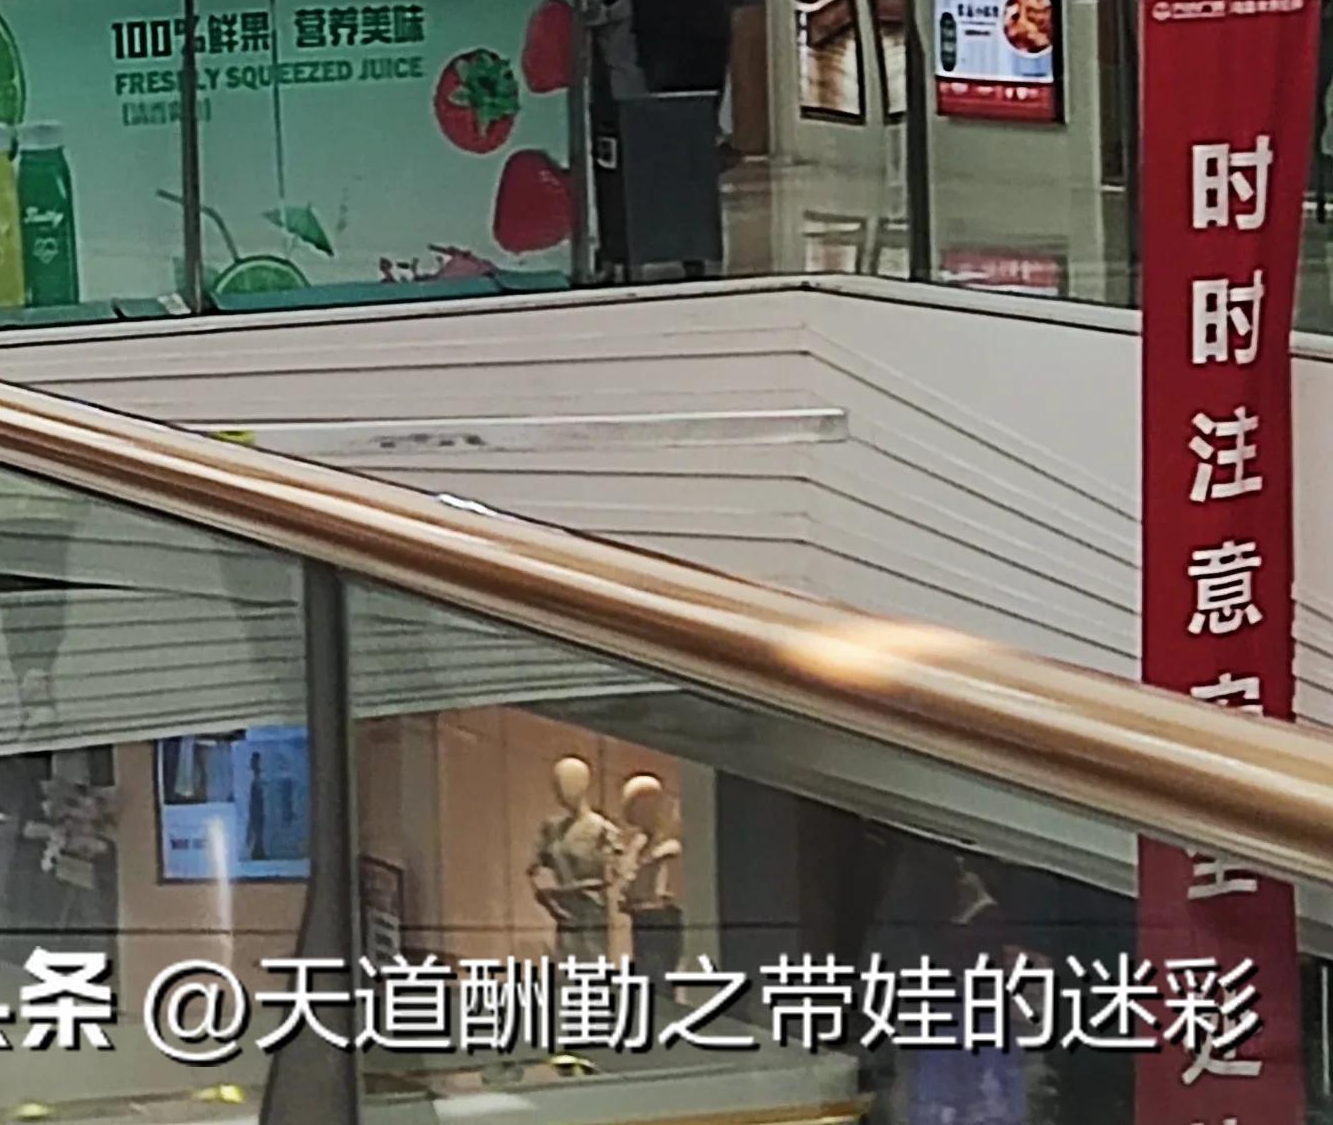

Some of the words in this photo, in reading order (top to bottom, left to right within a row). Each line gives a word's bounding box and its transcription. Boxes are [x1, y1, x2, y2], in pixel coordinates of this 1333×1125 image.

[294, 5, 425, 48] 营养美味
[115, 67, 220, 95] FRESLY
[358, 56, 424, 81] JUICE
